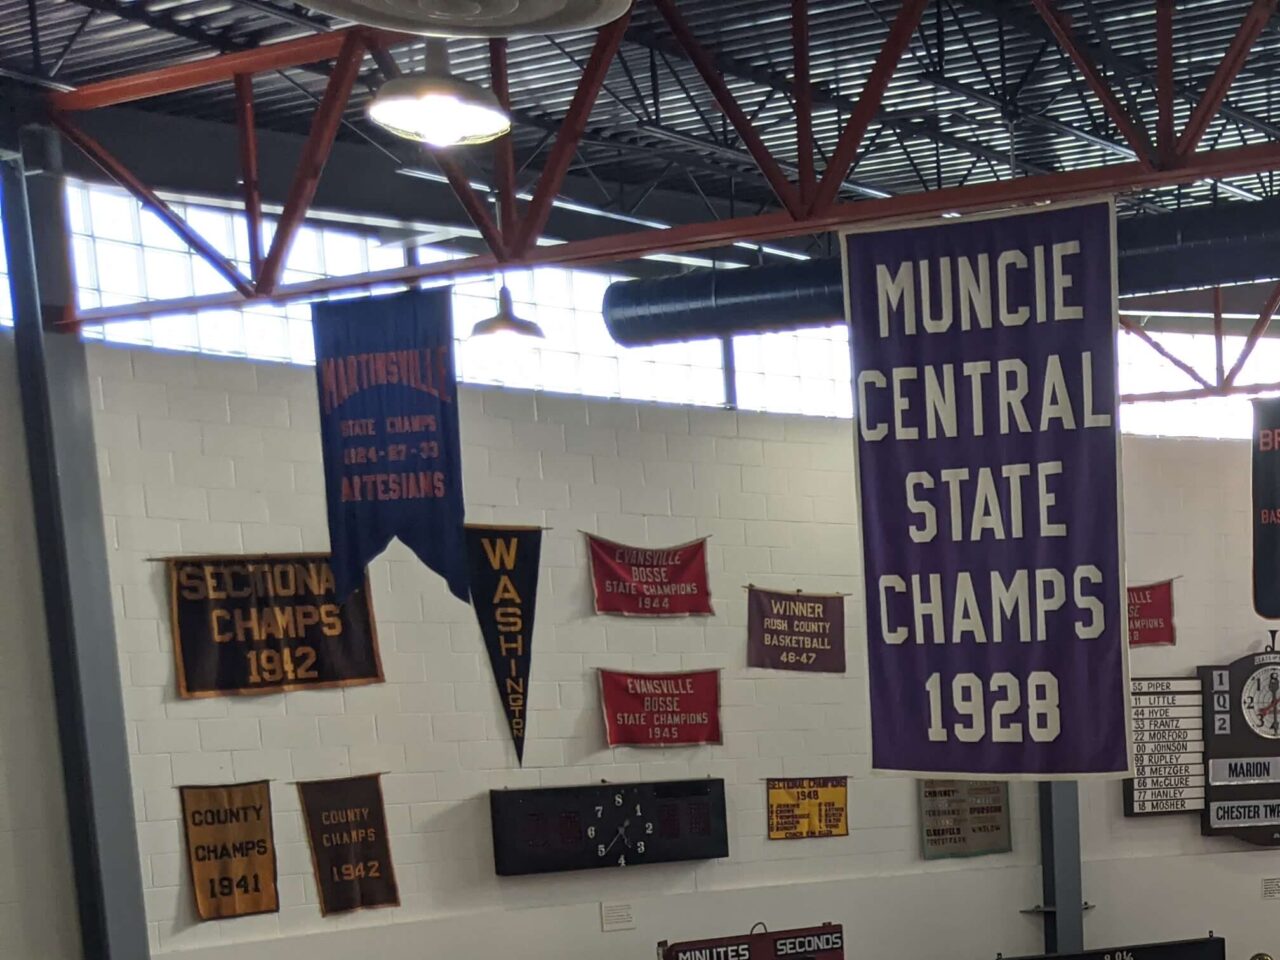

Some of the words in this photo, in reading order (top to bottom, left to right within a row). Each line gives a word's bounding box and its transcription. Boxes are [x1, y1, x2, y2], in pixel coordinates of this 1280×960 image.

[876, 240, 1083, 338] MUNCIE
[858, 352, 1111, 441] CENTRAL
[341, 419, 376, 436] STATE
[386, 415, 436, 432] CHAMPS
[905, 461, 1067, 542] STATE
[616, 550, 681, 565] EVANSVILLE
[631, 567, 667, 582] BOSSE
[606, 581, 637, 595] STATE
[643, 583, 697, 595] CHAMPIONS
[638, 598, 670, 608] 1944
[772, 600, 823, 618] WINNER
[878, 564, 1105, 644] CHAMPS
[211, 604, 341, 642] CHAMPS
[764, 618, 787, 631] RUSH
[793, 621, 831, 633] COUNTY
[481, 538, 523, 737] WASHINGTON
[765, 634, 831, 649] BASKETBALL
[247, 646, 318, 683] 1942
[627, 679, 694, 694] EVANSVILLE
[1148, 682, 1171, 691] PIPER
[1218, 673, 1224, 685] 1
[644, 697, 680, 712] BOSSE
[925, 671, 1061, 742] 1928
[1149, 696, 1176, 705] LITTLE
[1217, 695, 1226, 709] Q
[617, 713, 646, 724] STATE
[654, 713, 708, 724] CHAMPIONS
[1148, 708, 1170, 717] HYDE
[1149, 719, 1180, 728] FRANTZ
[1218, 718, 1227, 730] 2
[649, 727, 678, 738] 1945
[1149, 731, 1188, 740] MORFORD
[1150, 742, 1187, 752] JOHNSON
[1148, 754, 1180, 764] RUPLEY
[1150, 766, 1190, 776] METZGER
[1228, 762, 1270, 778] MARION
[1151, 778, 1189, 787] McCLURE
[1151, 789, 1184, 799] HANLEY
[1151, 800, 1186, 810] MOSHER
[191, 805, 263, 827] COUNTY
[322, 808, 369, 825] COUNTY
[1216, 806, 1260, 820] CHESTER
[323, 829, 375, 847] CHAMPS
[195, 840, 267, 862] CHAMPS
[332, 861, 380, 882] 1942
[208, 874, 261, 898] 1941
[777, 934, 842, 955] SECONDS
